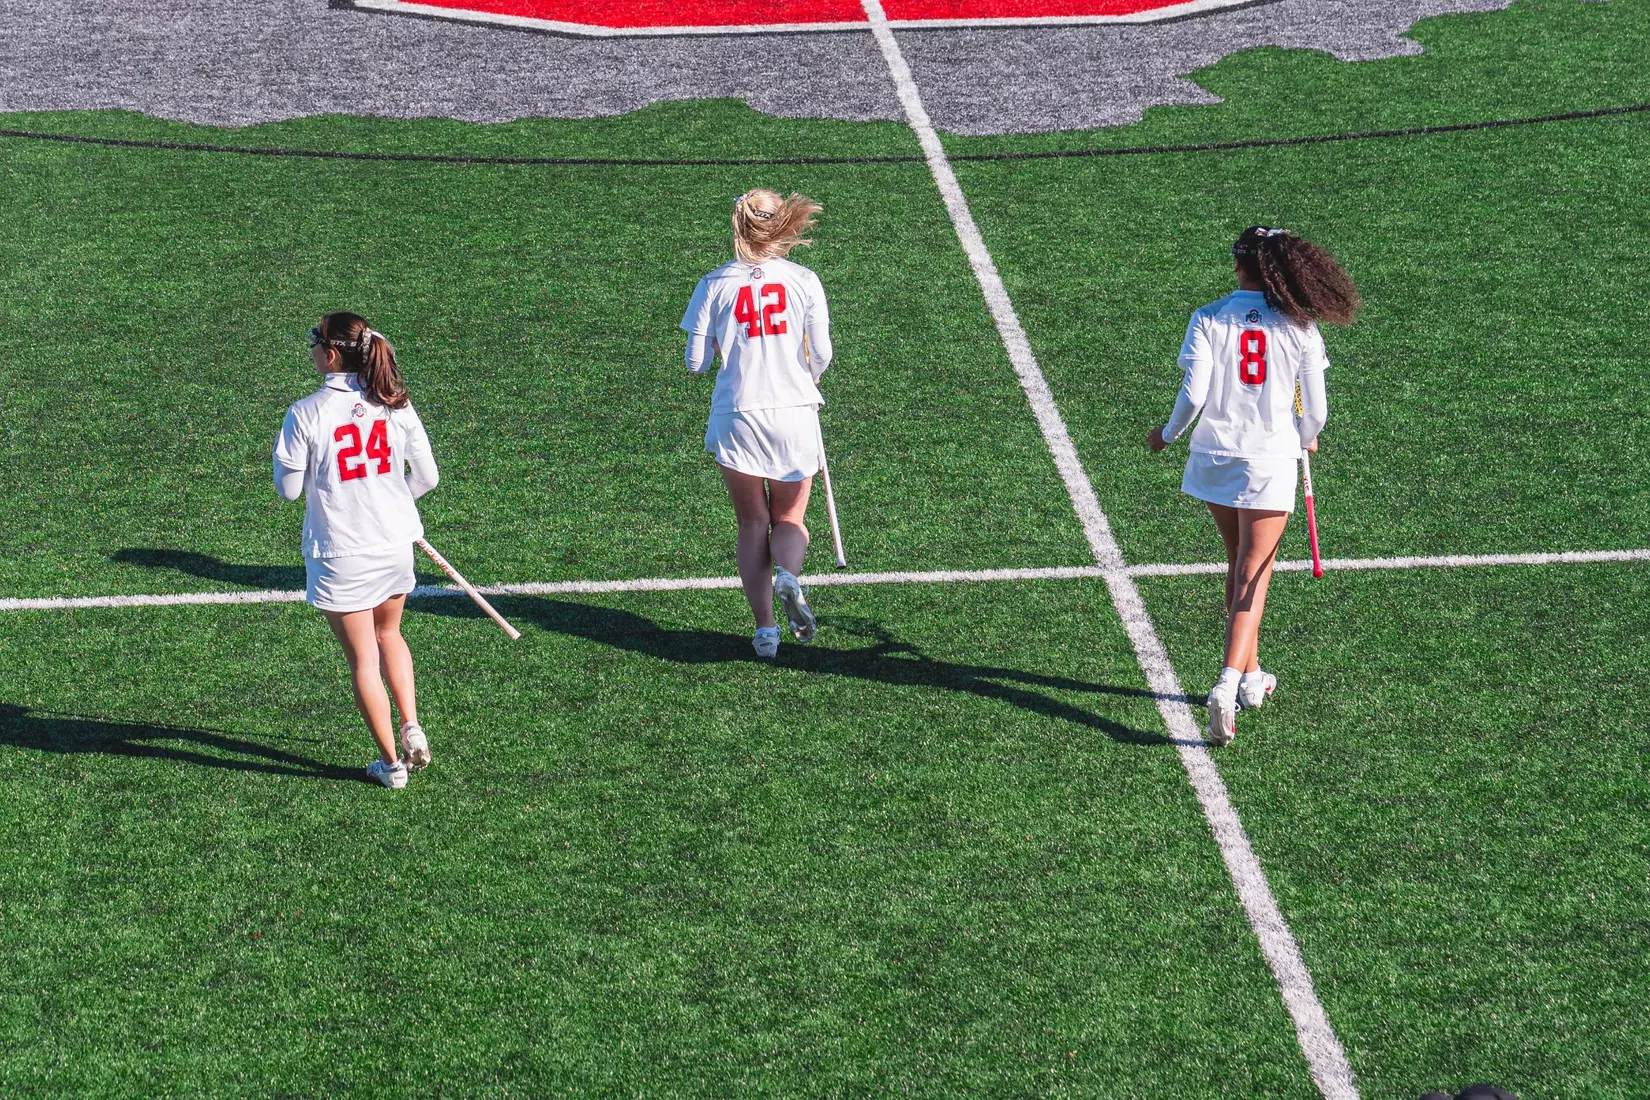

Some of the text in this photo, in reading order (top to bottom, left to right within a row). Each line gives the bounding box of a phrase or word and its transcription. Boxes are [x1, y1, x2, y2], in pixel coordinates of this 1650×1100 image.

[734, 283, 787, 338] 42
[330, 339, 346, 347] STX
[1239, 329, 1267, 385] 8
[333, 419, 392, 482] 24
